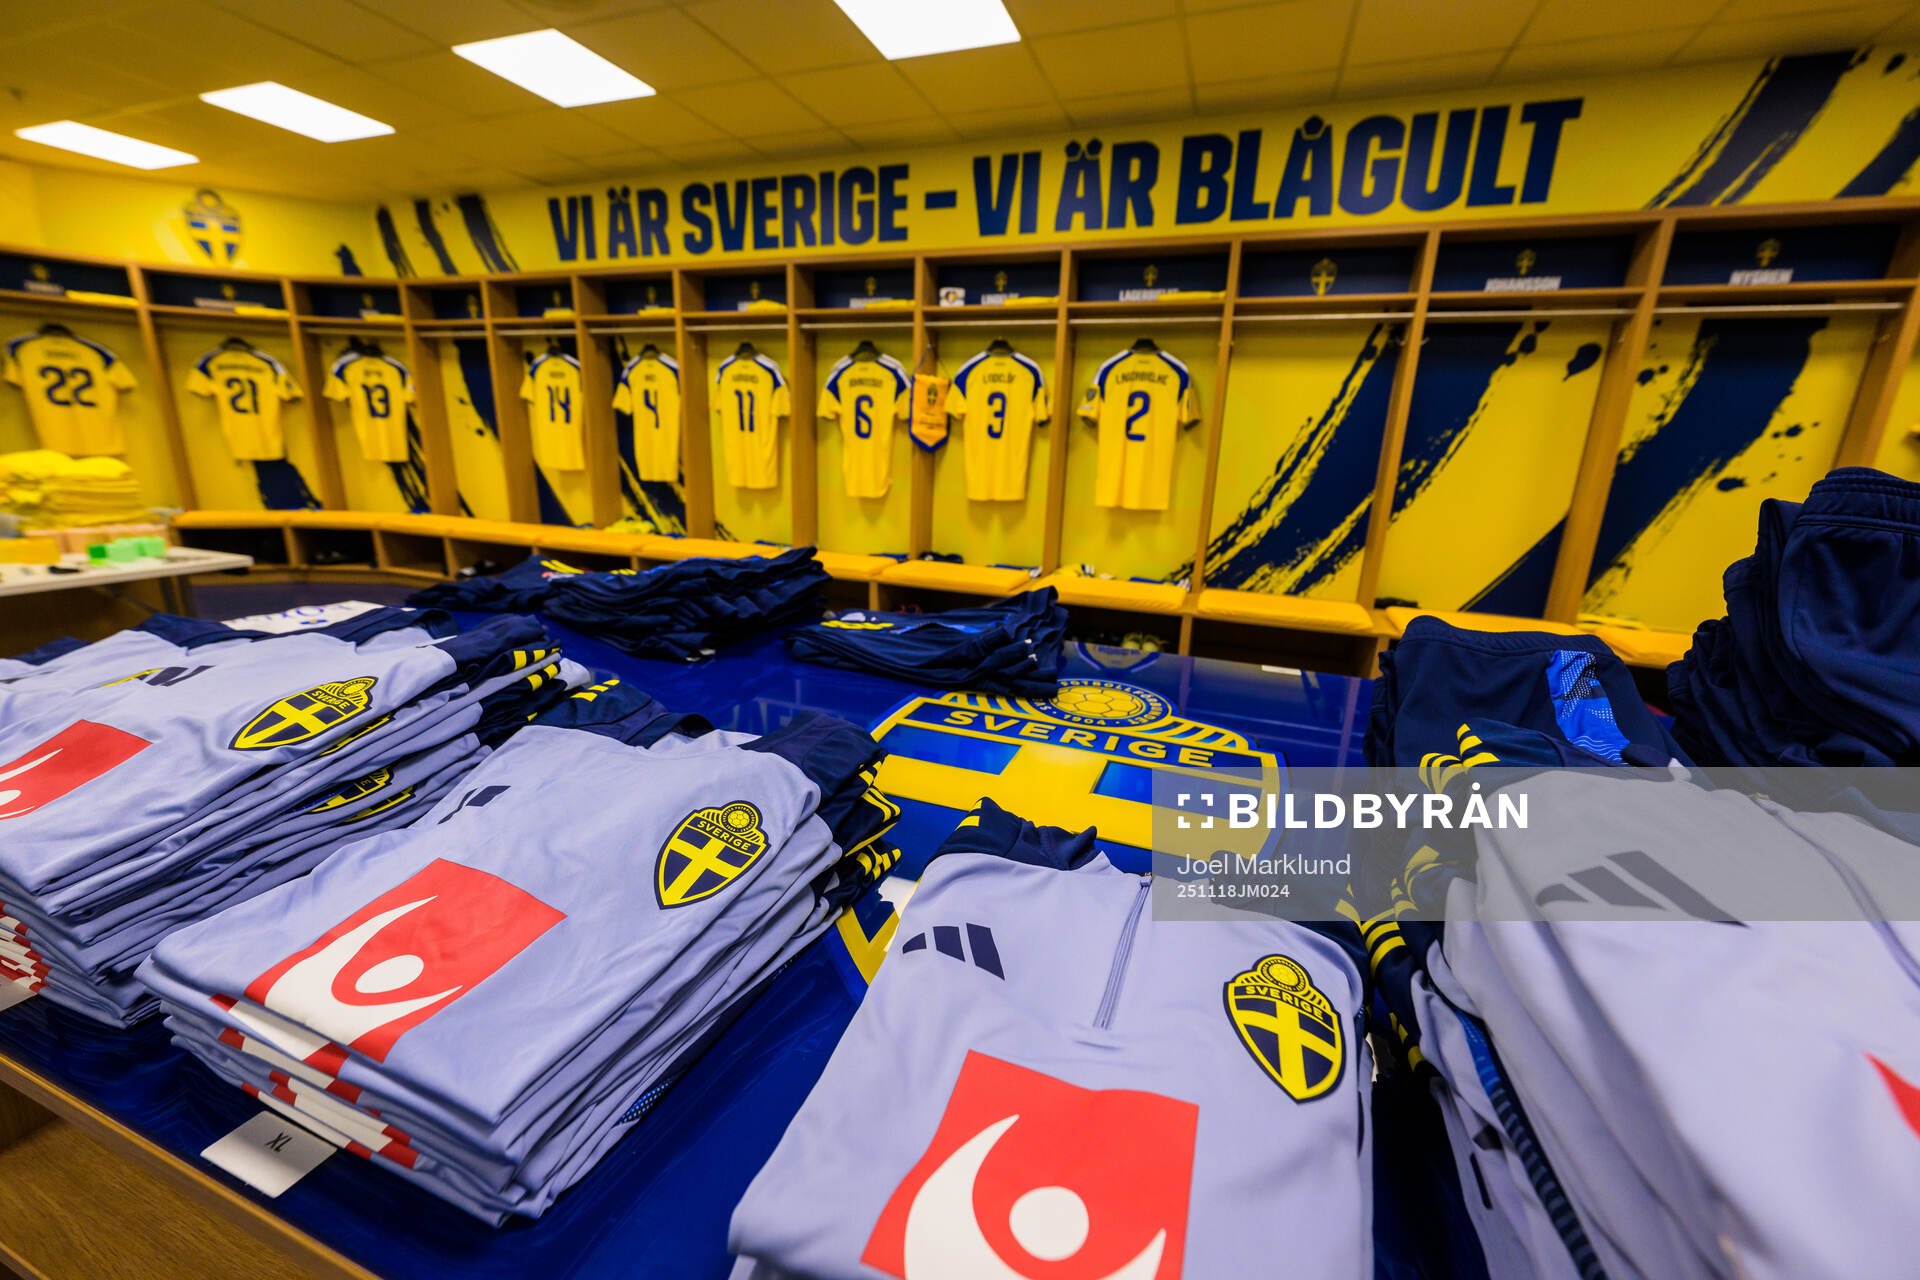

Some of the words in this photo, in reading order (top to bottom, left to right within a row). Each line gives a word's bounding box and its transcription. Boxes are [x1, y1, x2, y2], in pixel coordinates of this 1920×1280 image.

[548, 196, 597, 261] VI
[607, 186, 671, 258] ÄR
[681, 163, 910, 255] SVERIGE
[973, 151, 1042, 236] VI
[1055, 138, 1160, 231] ÄR
[1175, 97, 1585, 225] BLÅGULT
[40, 366, 96, 408] 22
[226, 377, 260, 415] 21
[362, 383, 391, 419] 13
[547, 385, 571, 424] 14
[644, 389, 660, 429] 4
[734, 389, 755, 433] 11
[855, 394, 875, 440] 6
[987, 392, 1008, 440] 3
[1125, 390, 1152, 442] 2
[943, 710, 1214, 768] SVERIGE
[697, 820, 752, 852] SVERIGE
[1245, 985, 1325, 1021] SVERIGE
[263, 1132, 293, 1152] XL
